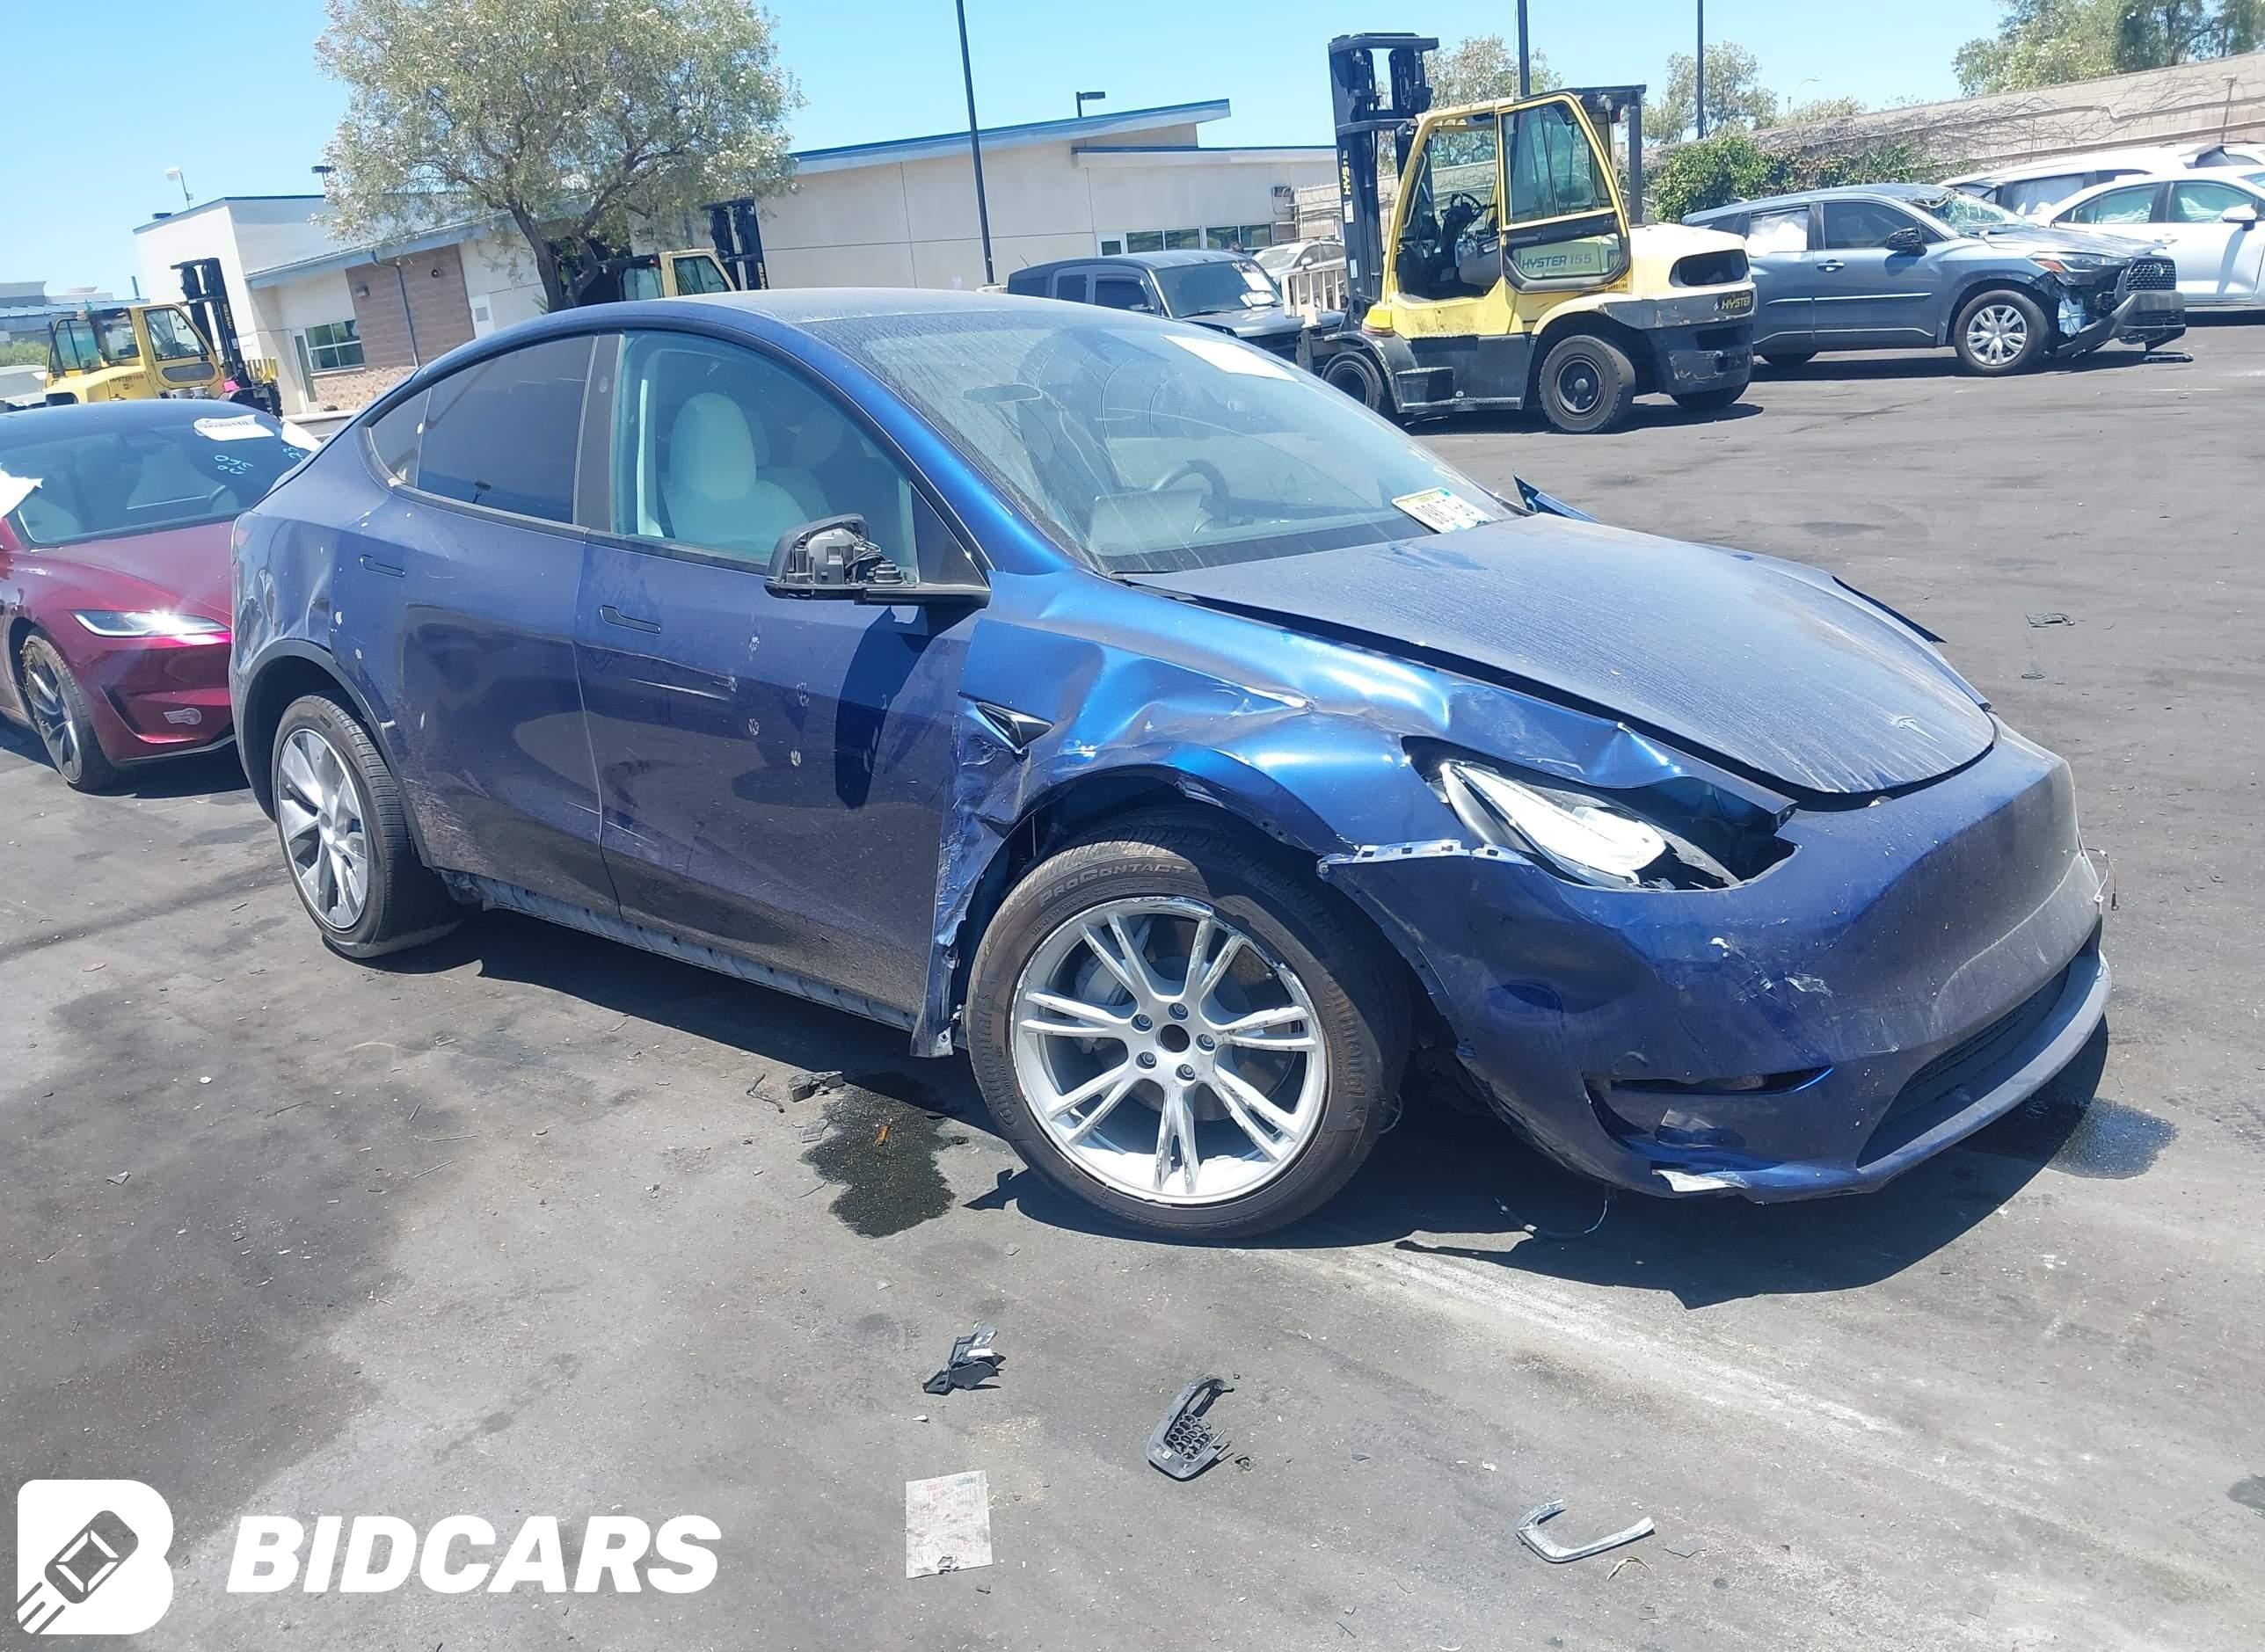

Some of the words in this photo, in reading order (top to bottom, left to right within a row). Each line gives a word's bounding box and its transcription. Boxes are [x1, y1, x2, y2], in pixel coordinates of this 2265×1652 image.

[1522, 255, 1567, 270] HYSTER
[1569, 253, 1592, 265] 155
[757, 263, 767, 289] YSTER
